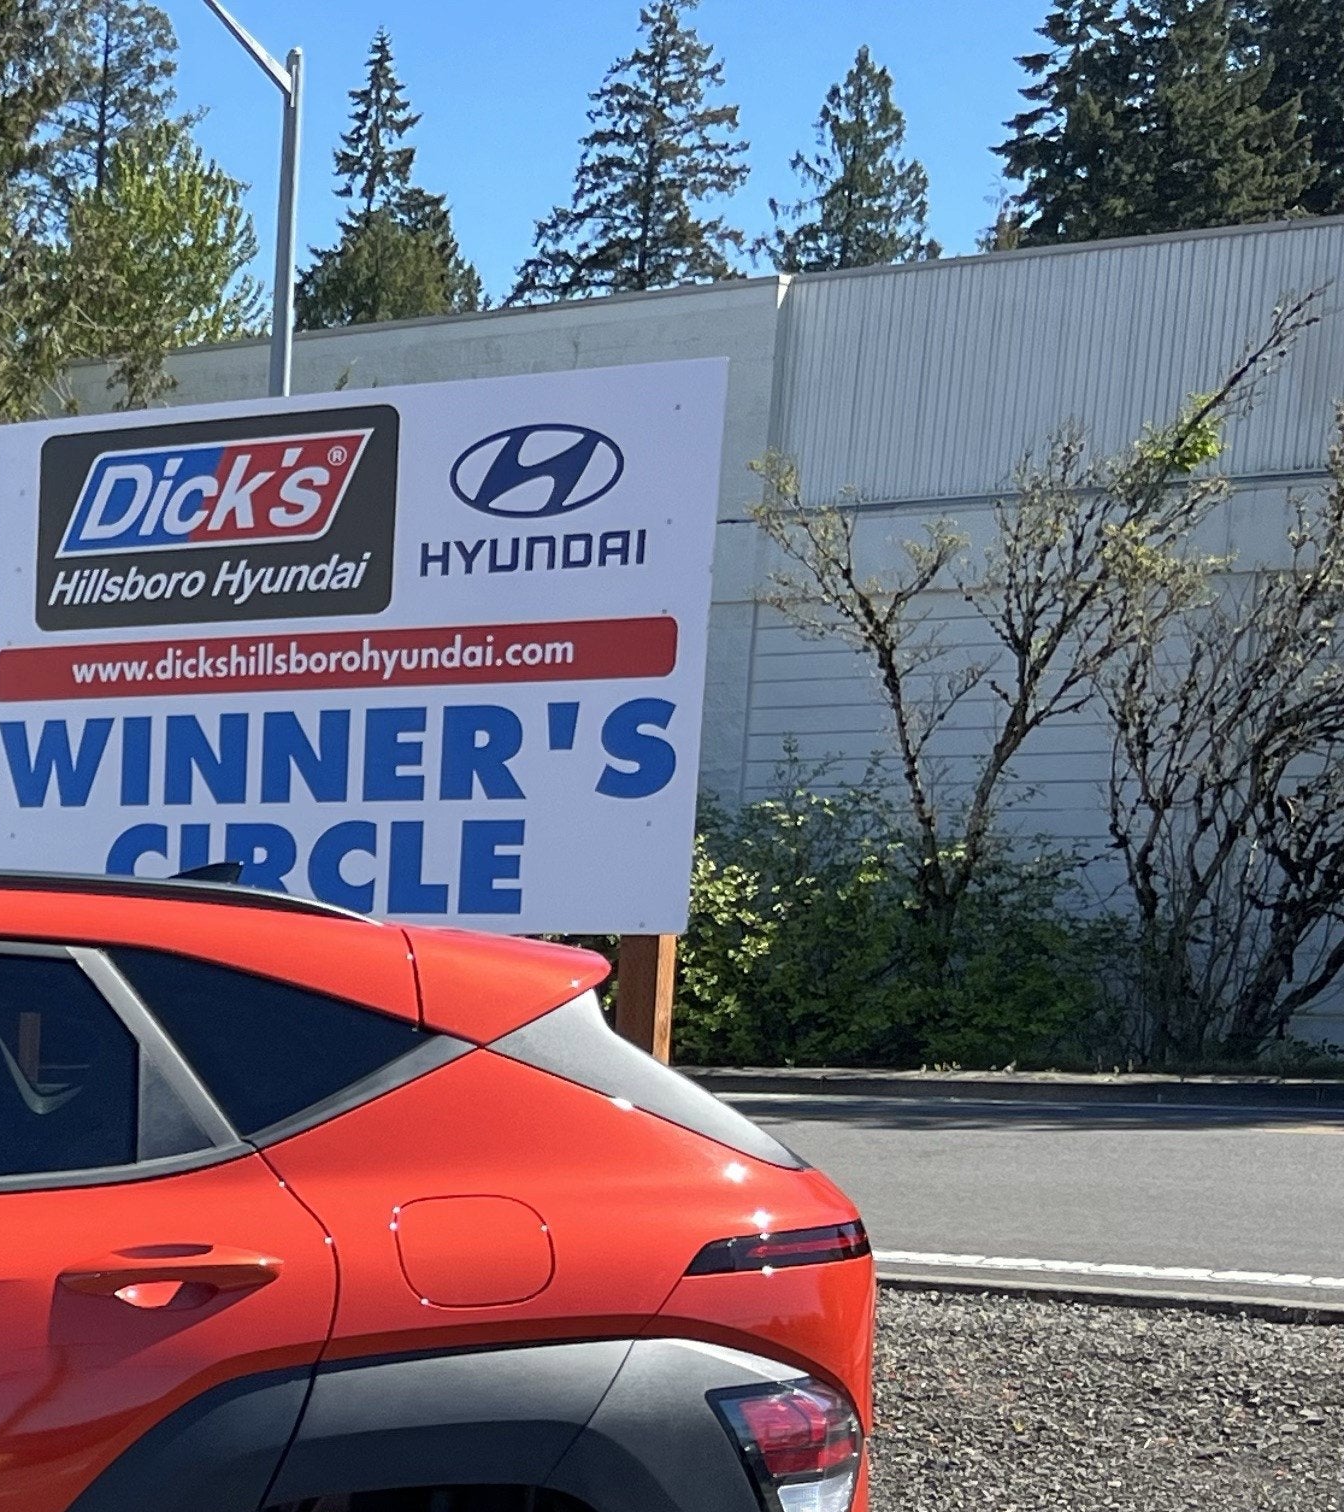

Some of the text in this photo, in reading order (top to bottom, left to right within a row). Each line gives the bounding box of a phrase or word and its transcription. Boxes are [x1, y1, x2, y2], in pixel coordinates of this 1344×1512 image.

[79, 447, 331, 541] Dick's
[47, 551, 373, 607] Hillsboro Hyundai
[420, 529, 647, 577] HYUNDAI
[72, 636, 575, 685] www.dickshillsborohyundai.com
[0, 698, 677, 808] WINNER'S
